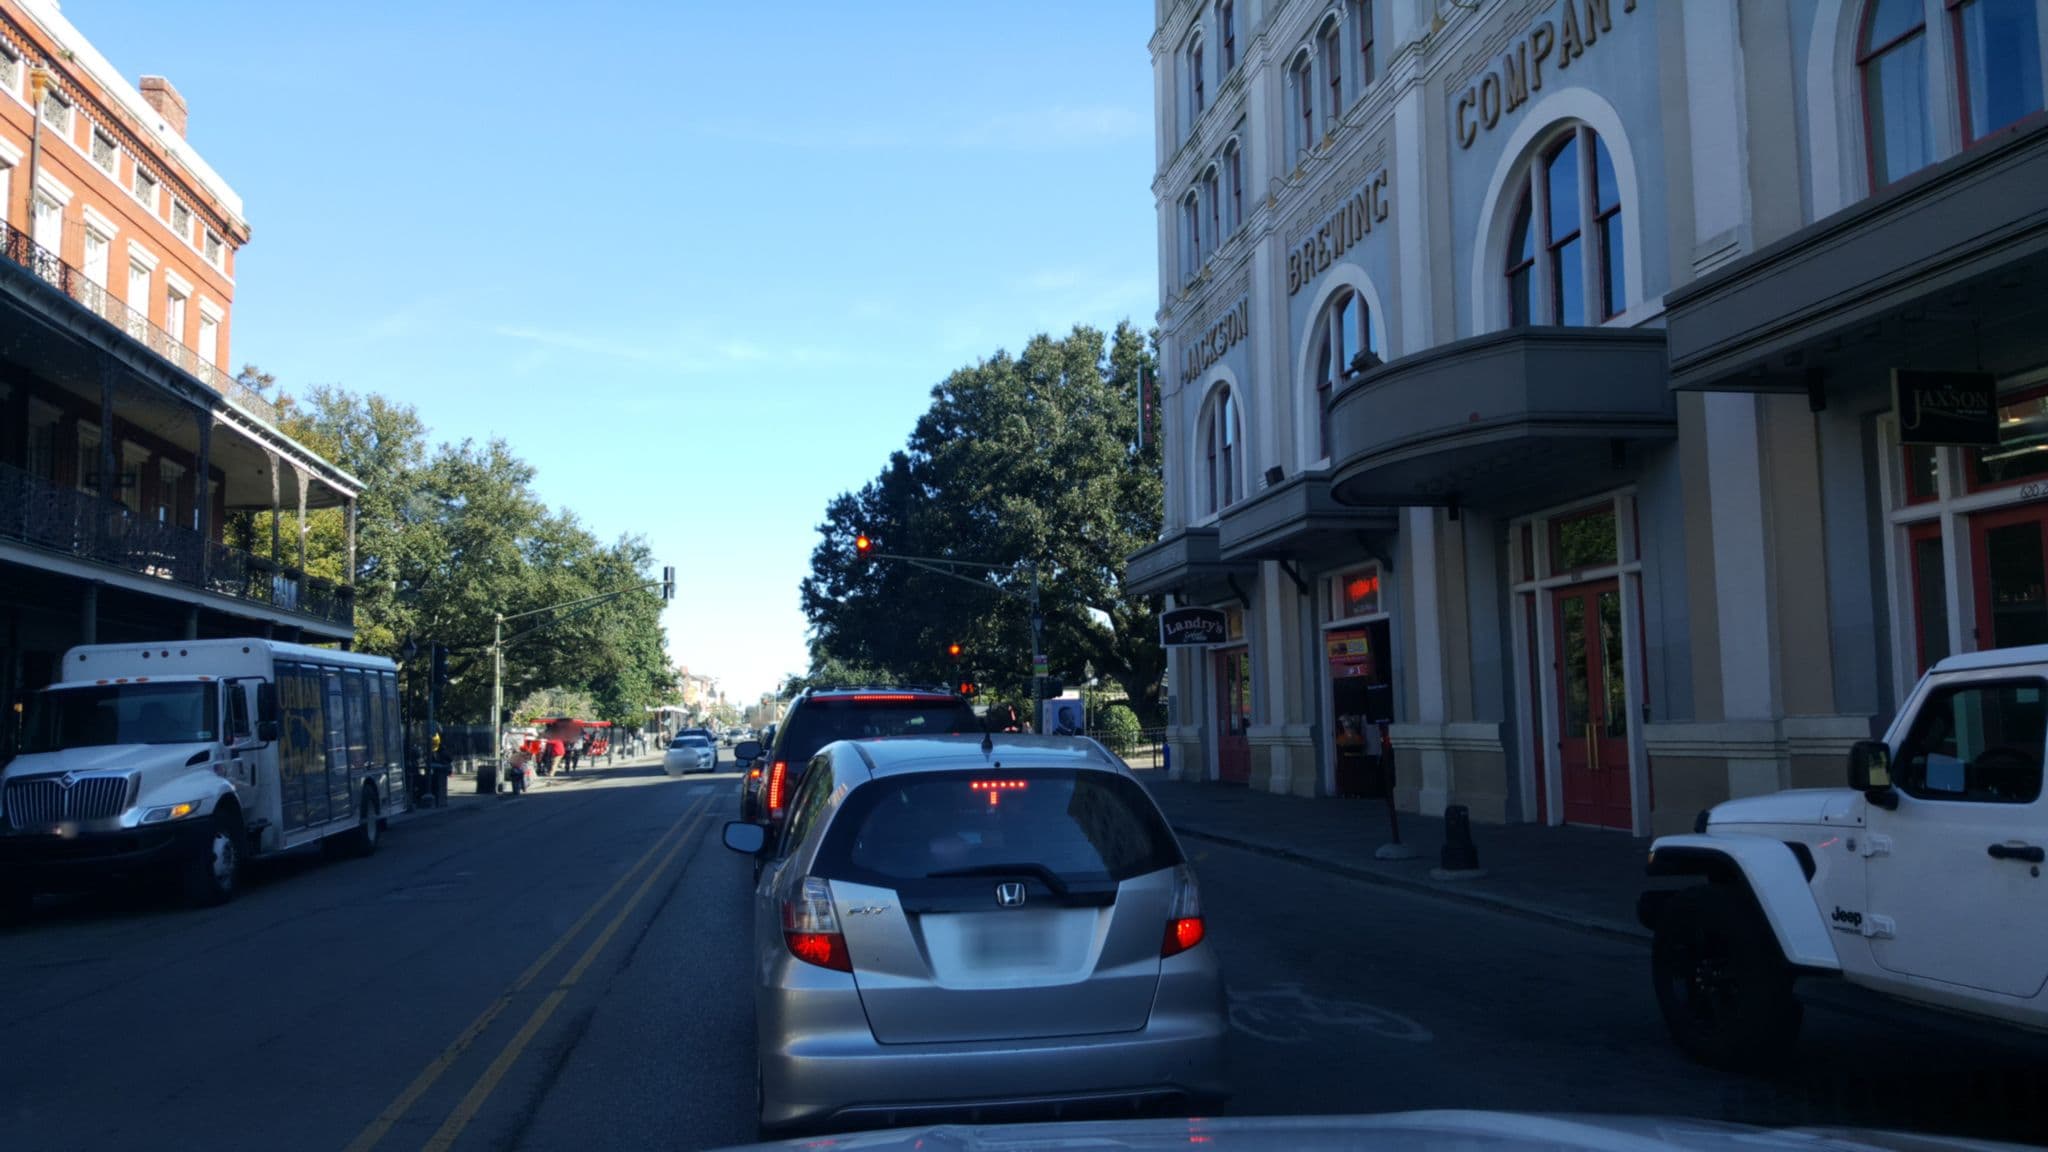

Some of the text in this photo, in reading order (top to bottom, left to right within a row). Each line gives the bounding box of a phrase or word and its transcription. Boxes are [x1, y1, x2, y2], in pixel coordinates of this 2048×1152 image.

[1183, 0, 1636, 385] JACKSON BREWING COMPAN
[1903, 390, 1990, 430] JAXSON
[1165, 616, 1224, 635] Landry's
[1831, 905, 1862, 927] Jeep
